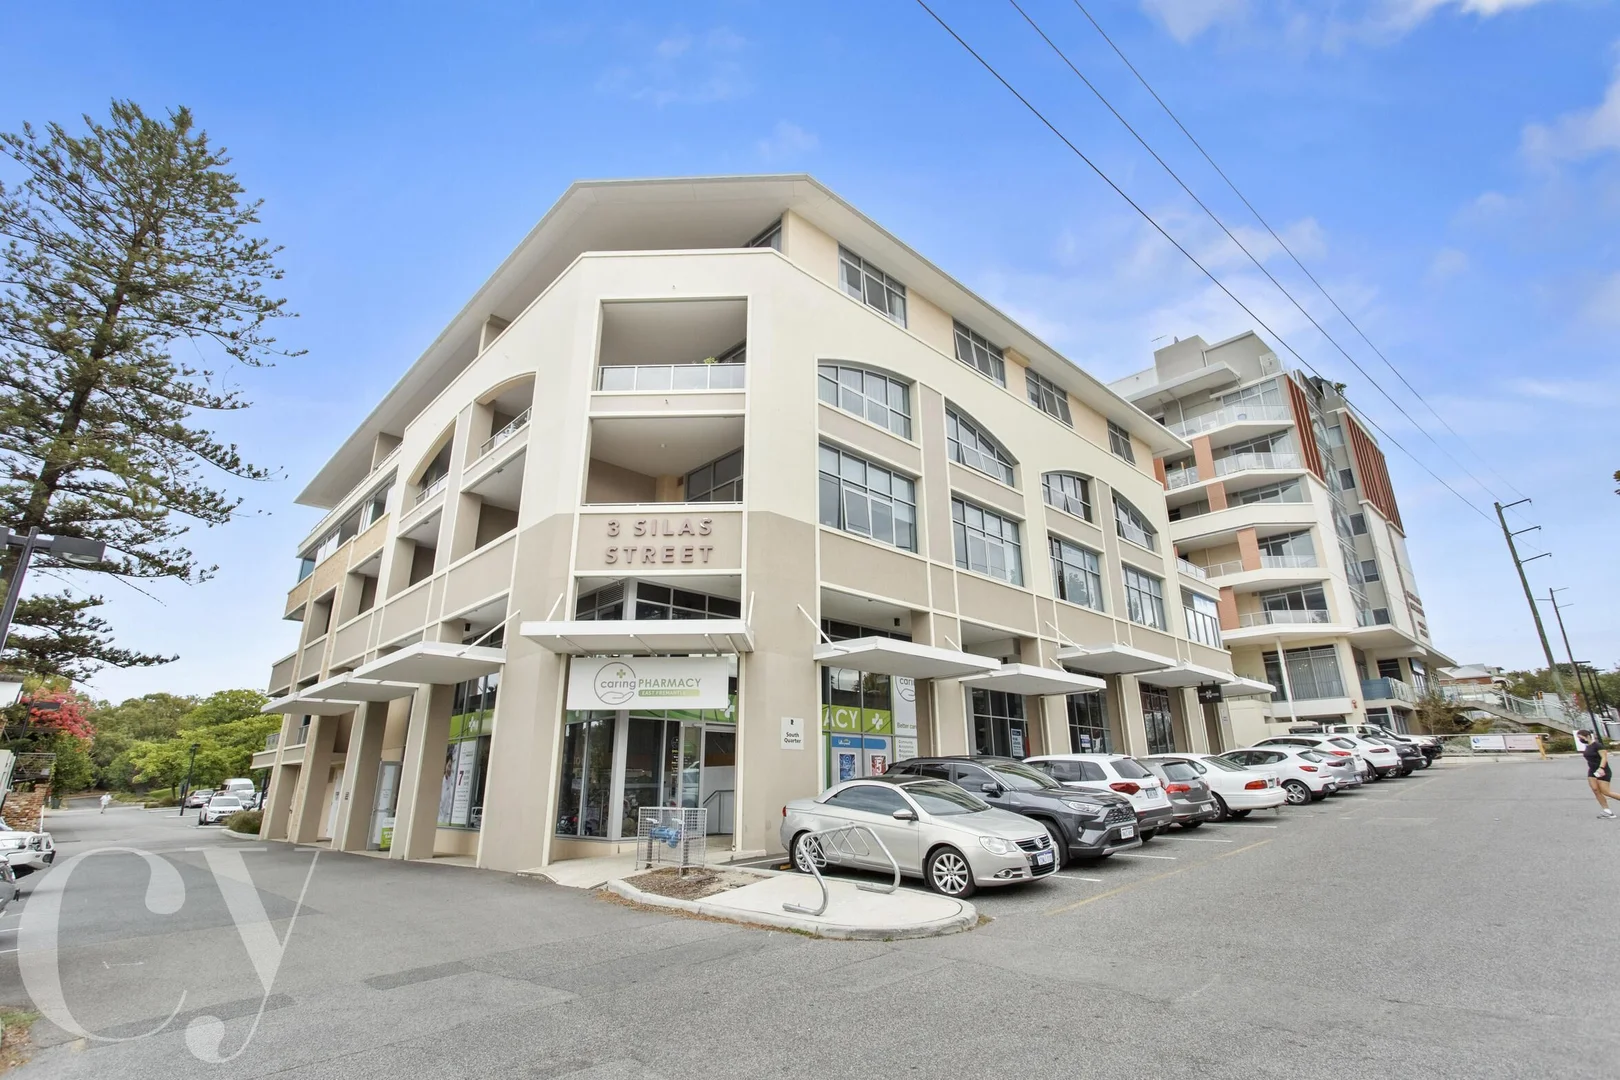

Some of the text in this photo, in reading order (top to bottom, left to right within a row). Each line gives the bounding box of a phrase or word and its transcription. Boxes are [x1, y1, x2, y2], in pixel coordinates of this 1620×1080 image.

[607, 517, 712, 537] 3 SILAS
[605, 545, 714, 564] STREET
[600, 677, 701, 690] caring PHARMACY
